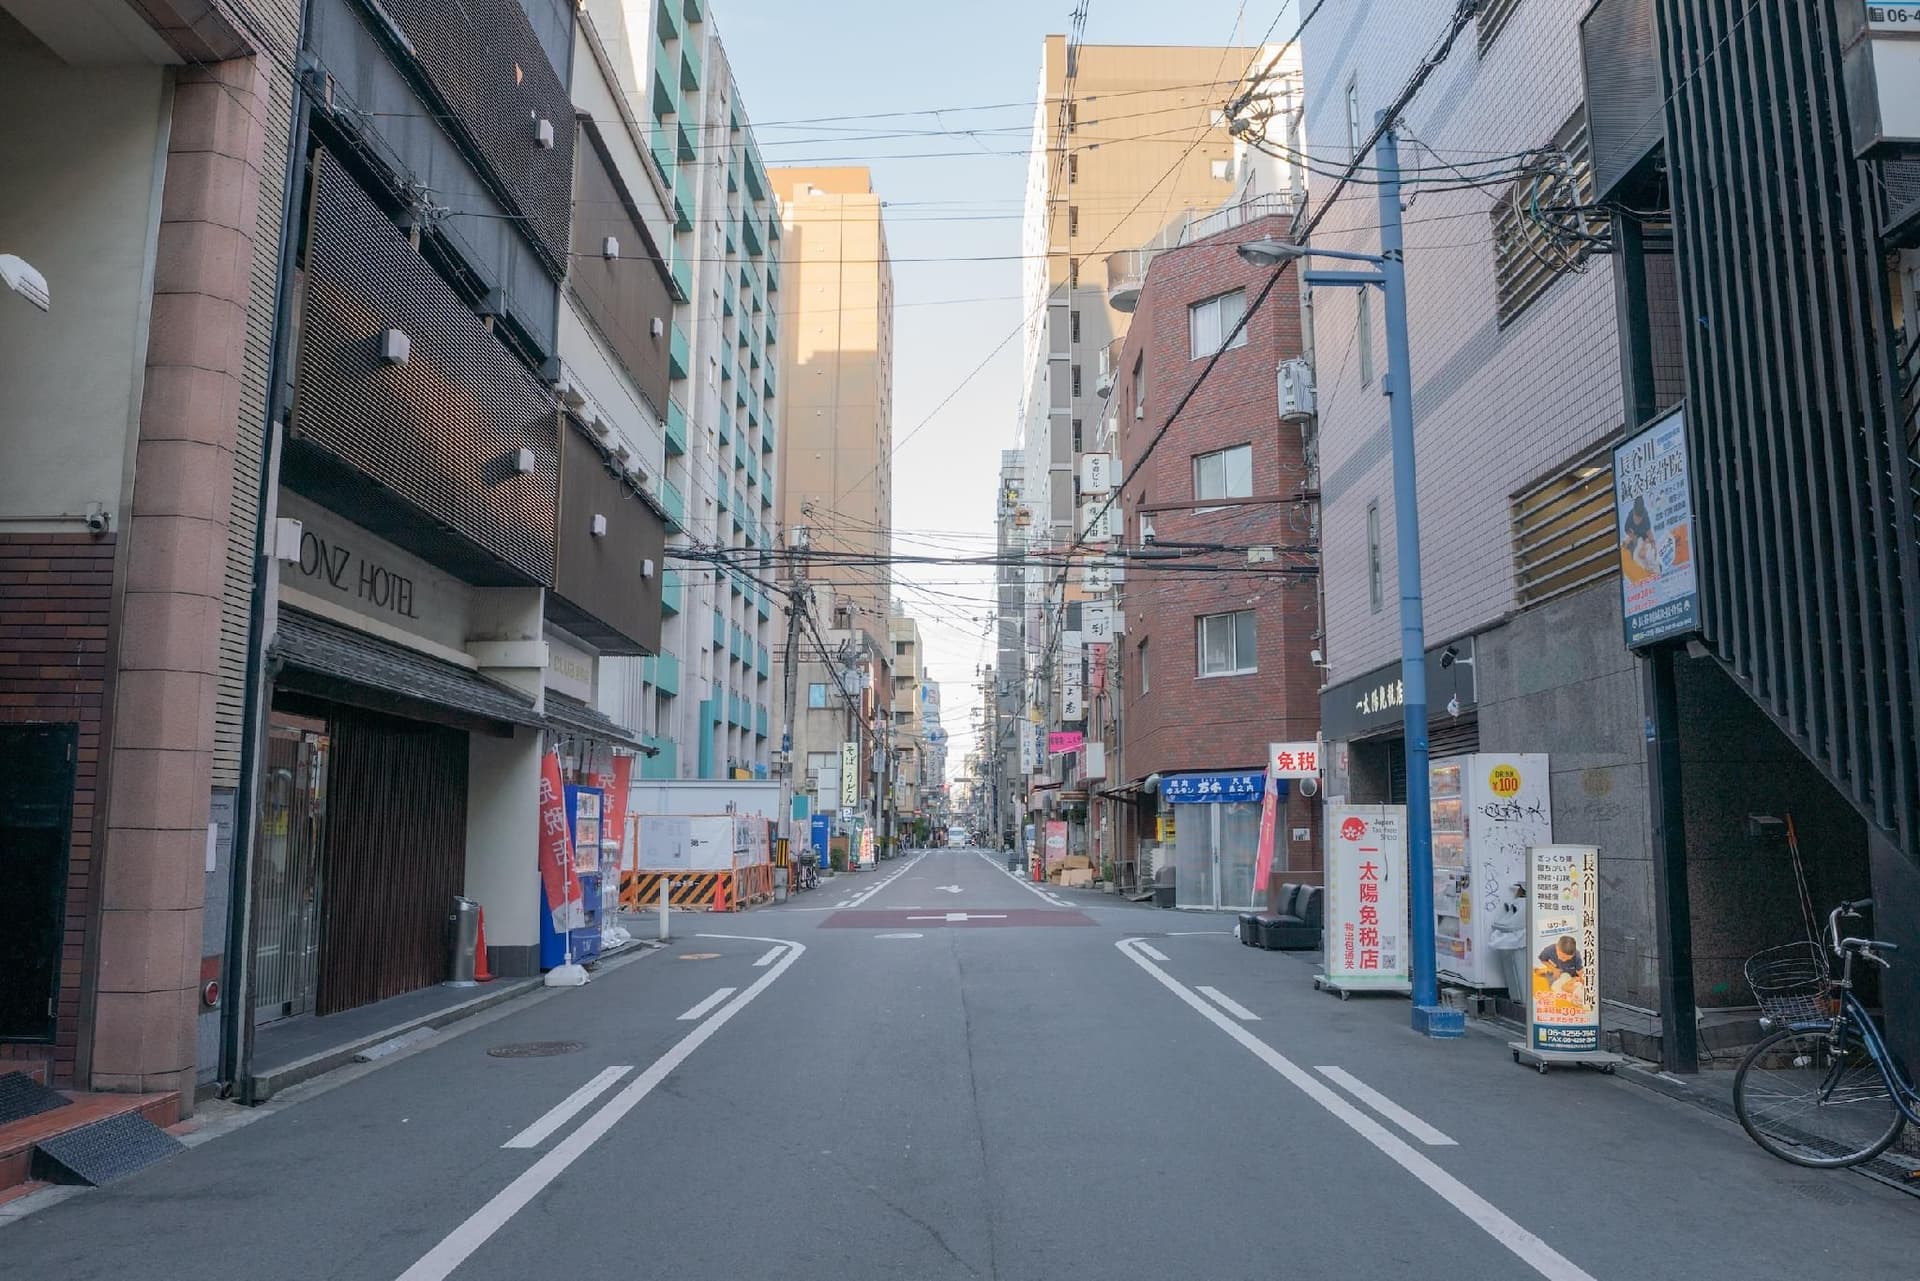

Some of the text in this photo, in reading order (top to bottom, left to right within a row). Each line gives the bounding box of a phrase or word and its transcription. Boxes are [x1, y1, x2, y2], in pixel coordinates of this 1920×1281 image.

[1620, 439, 1655, 477] 長谷川
[289, 532, 419, 619] ONZ HOTEL
[1277, 751, 1317, 771] 免税
[1495, 770, 1514, 778] DRINK
[1492, 777, 1518, 792] ¥100
[1358, 847, 1379, 970] 一太陽免税店
